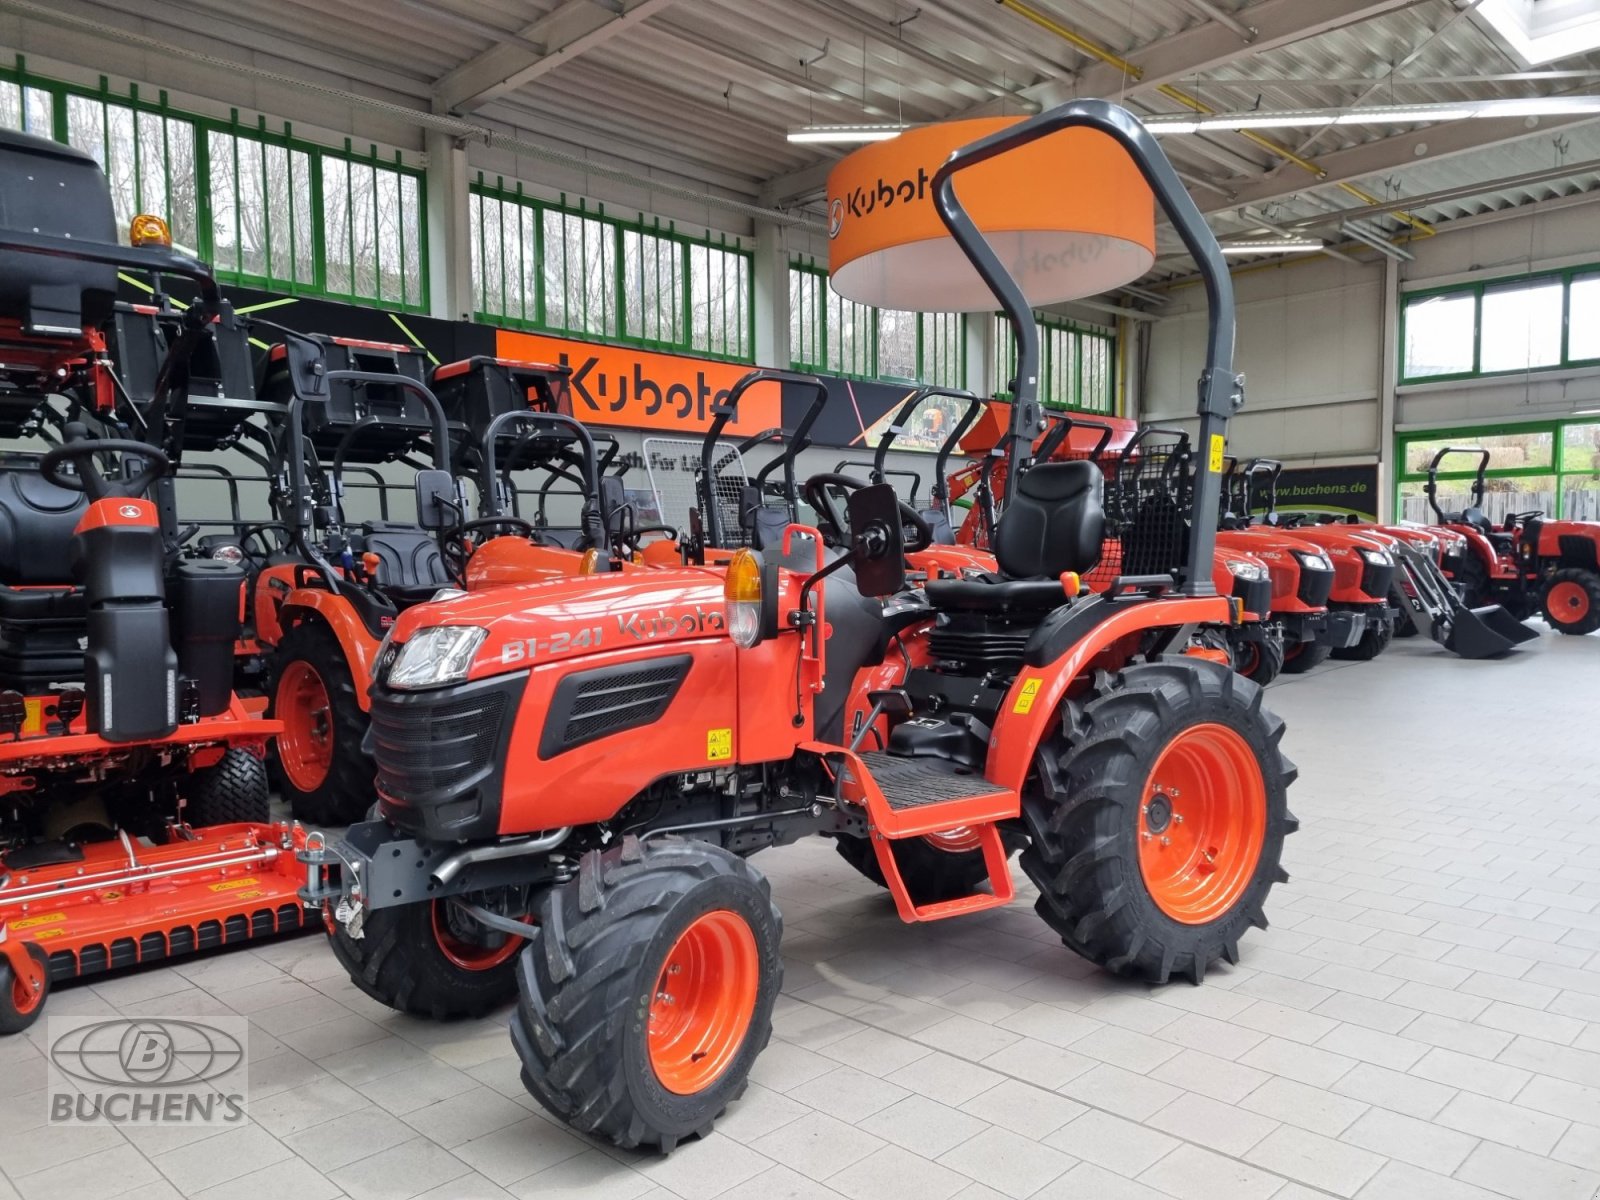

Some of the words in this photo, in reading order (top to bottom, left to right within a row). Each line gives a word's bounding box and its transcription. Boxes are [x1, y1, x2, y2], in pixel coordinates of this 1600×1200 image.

[847, 168, 932, 218] Kubot
[559, 353, 738, 424] Kubota
[616, 606, 724, 640] Kubota
[501, 627, 603, 664] B1-241
